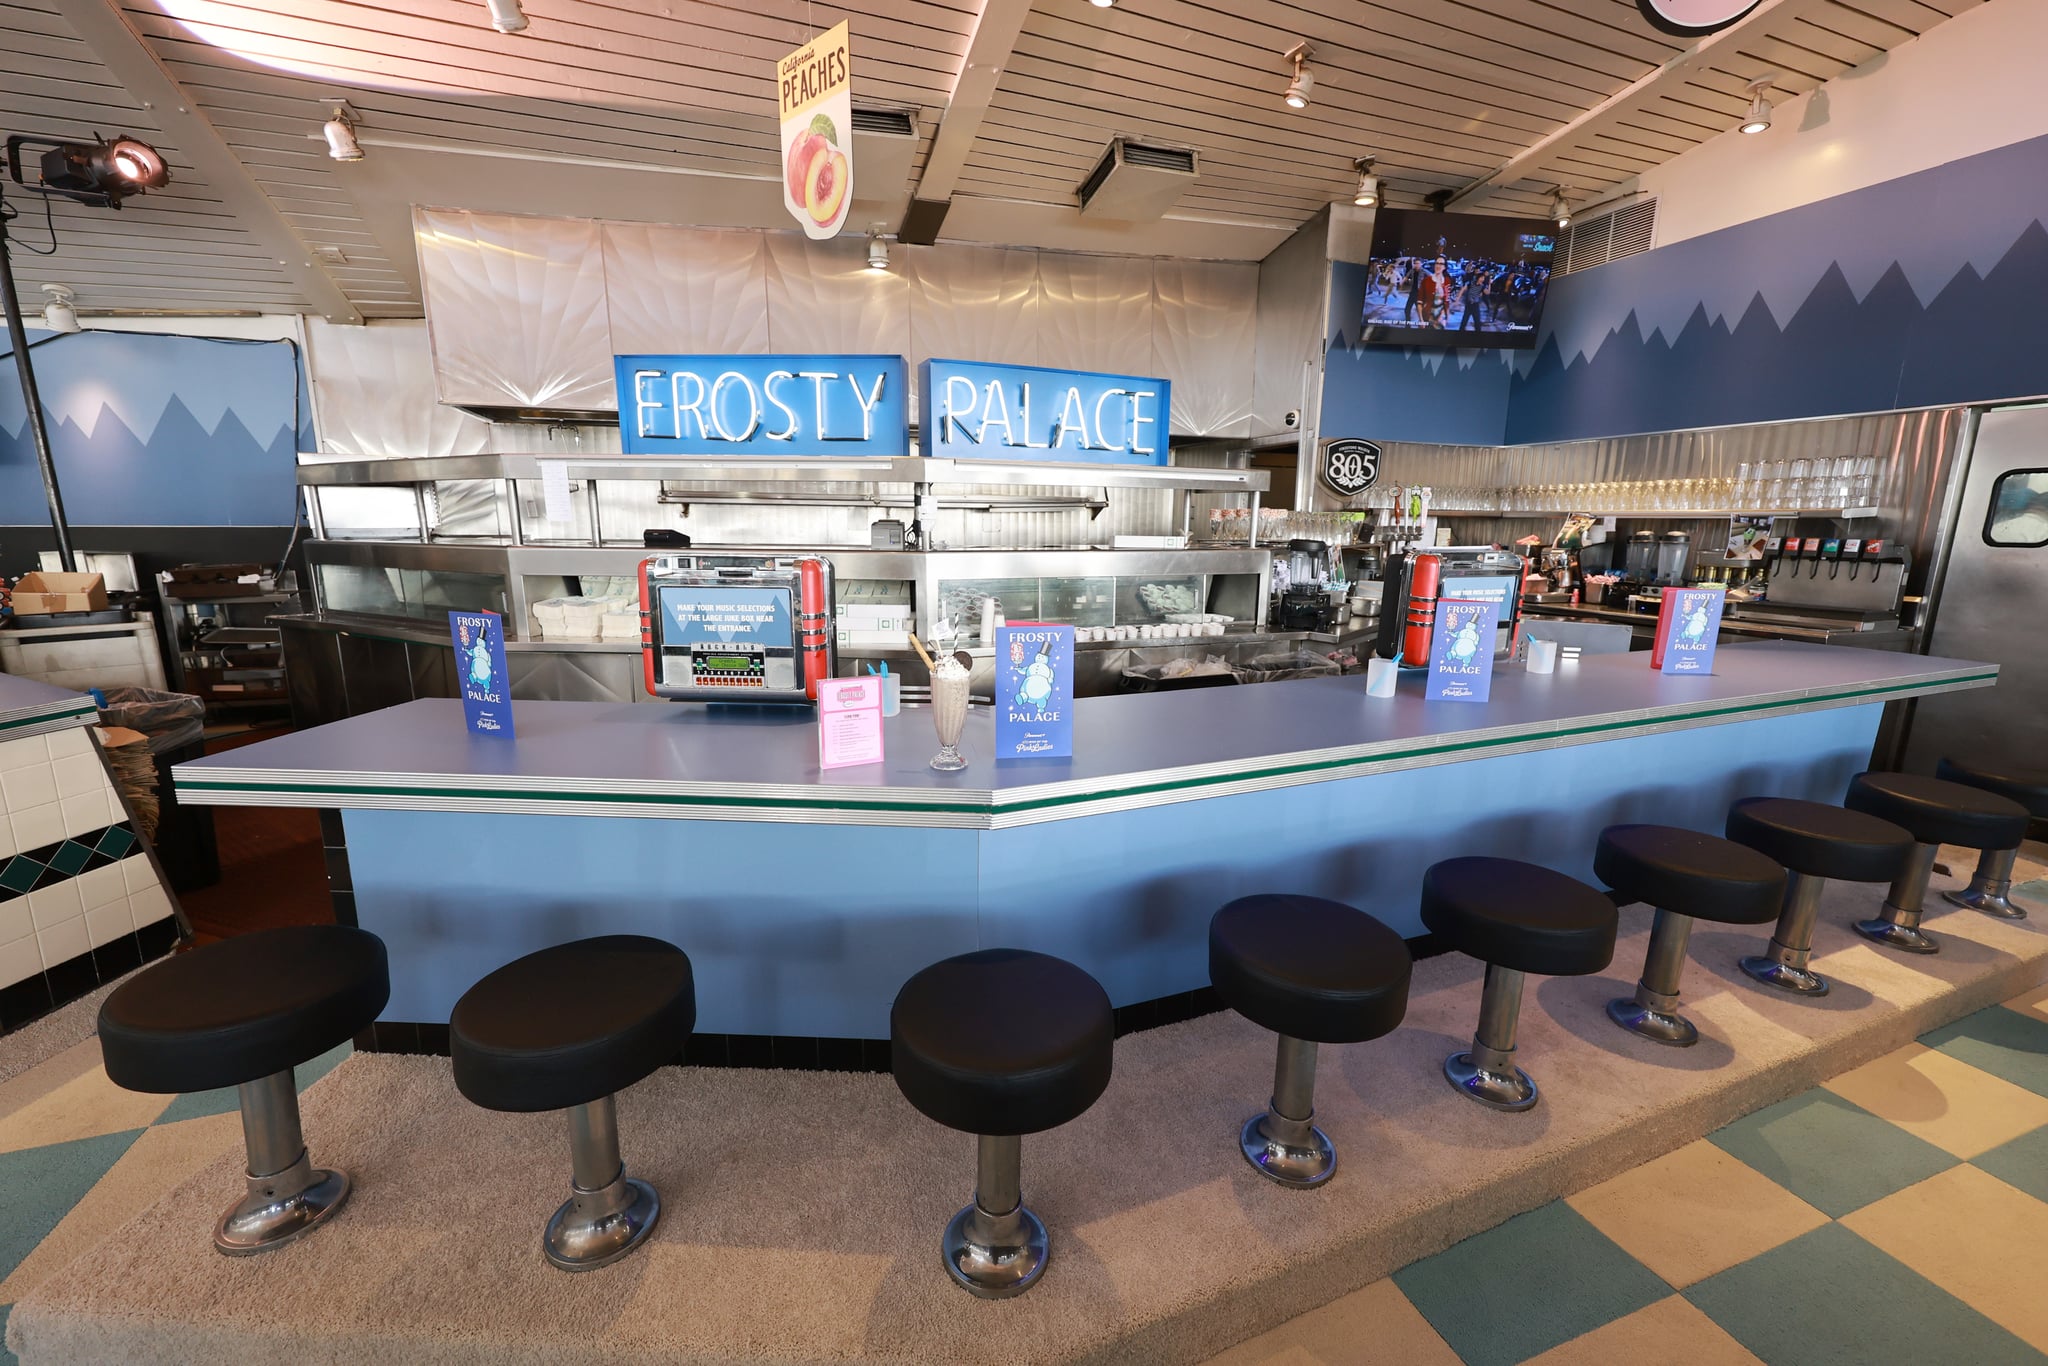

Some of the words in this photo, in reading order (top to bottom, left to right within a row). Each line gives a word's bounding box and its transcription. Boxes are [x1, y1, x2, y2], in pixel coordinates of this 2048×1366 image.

[783, 47, 815, 76] California
[782, 46, 846, 113] PEACHES
[635, 370, 886, 442] FROSTY
[946, 376, 1155, 453] PALACE
[1329, 453, 1376, 480] 805
[1683, 592, 1717, 600] FROSTY
[1446, 606, 1490, 614] FROSTY
[456, 616, 492, 628] FROSTY
[1009, 632, 1063, 642] FROSTY
[1440, 666, 1481, 674] PALACE
[468, 690, 502, 704] PALACE
[1010, 712, 1060, 722] PALACE
